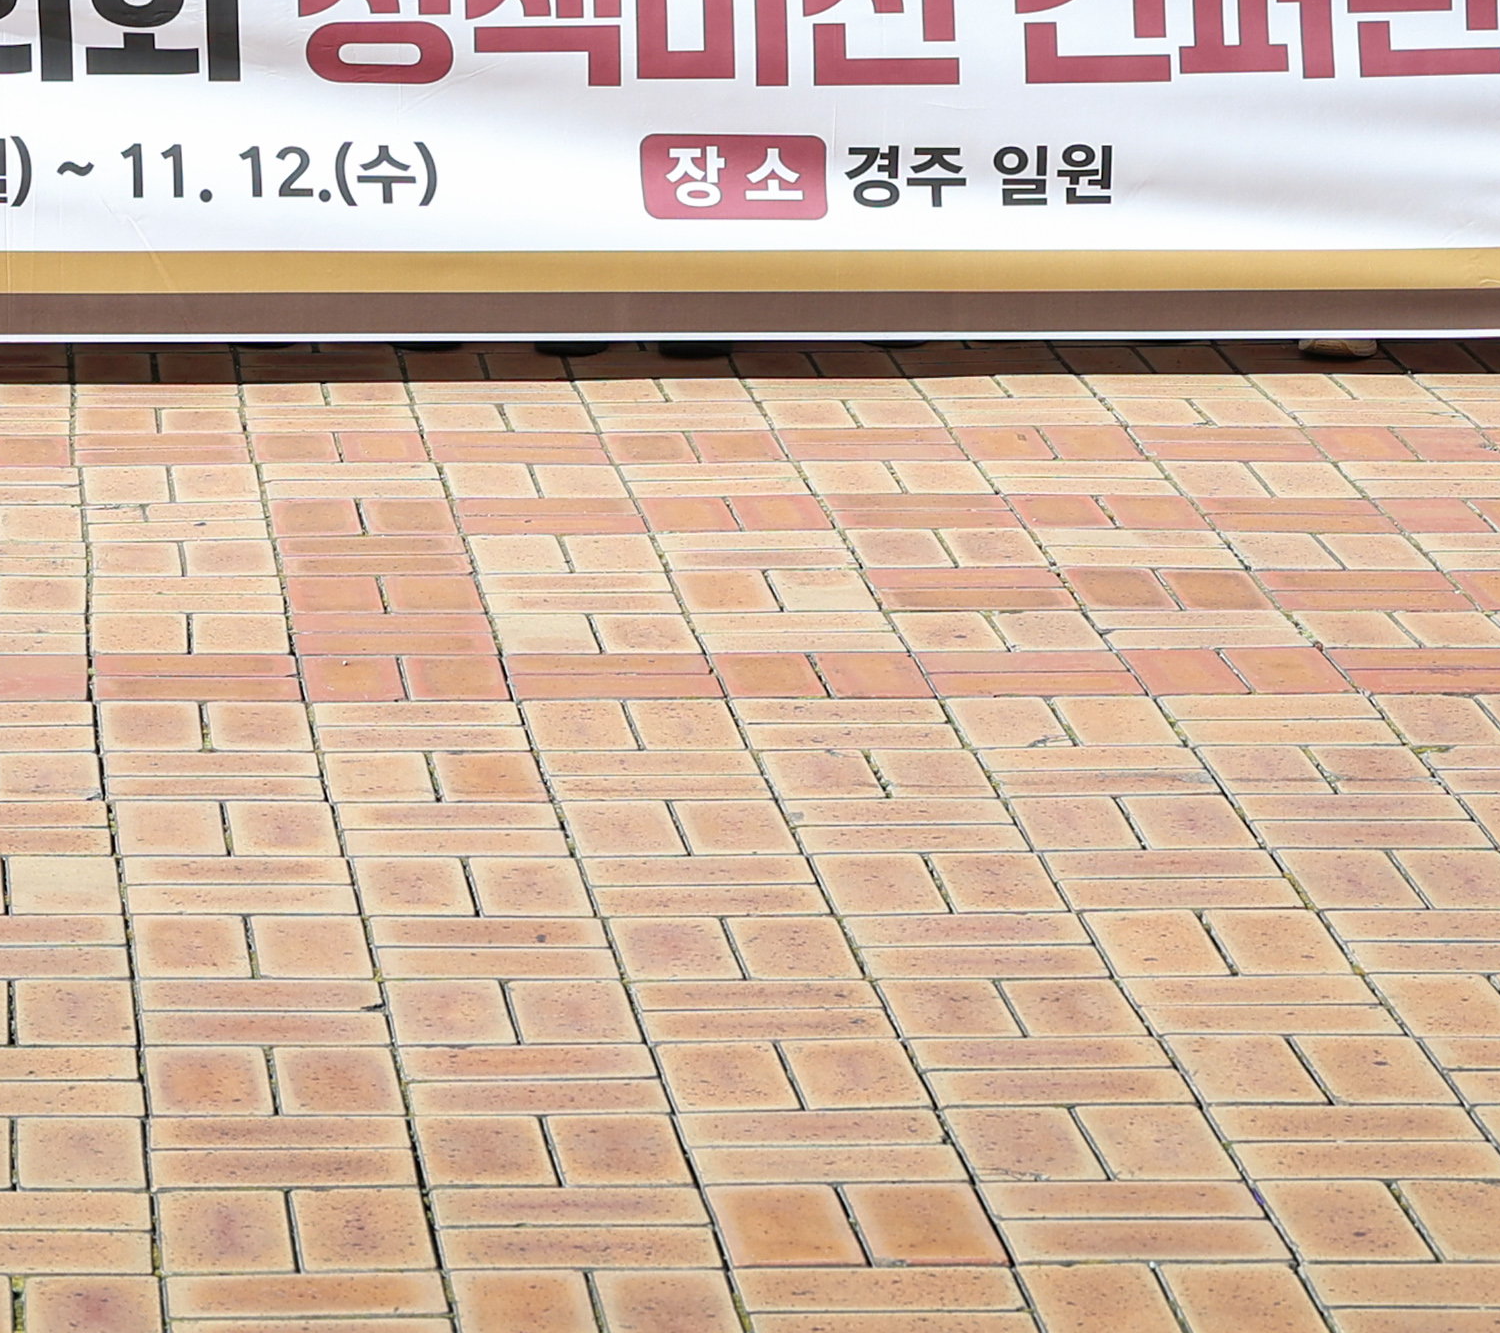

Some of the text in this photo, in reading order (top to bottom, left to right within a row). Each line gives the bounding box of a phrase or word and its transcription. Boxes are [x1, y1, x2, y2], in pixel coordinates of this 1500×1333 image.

[121, 143, 212, 203] 11.
[239, 141, 438, 207] 12.(수)
[844, 144, 1113, 208] 경주 일원
